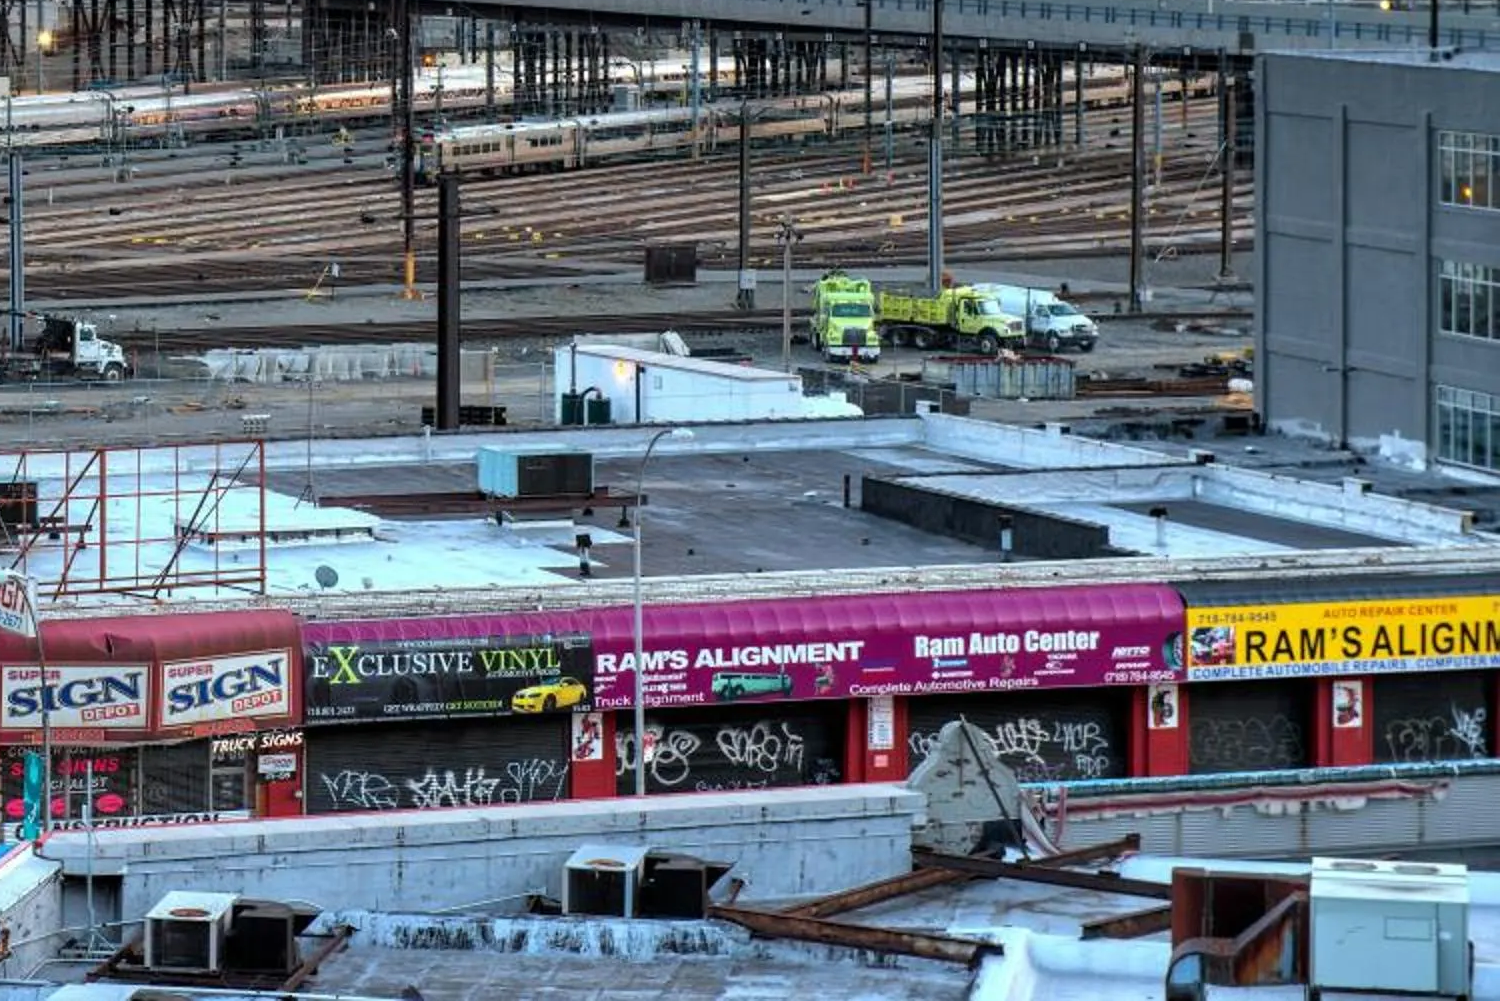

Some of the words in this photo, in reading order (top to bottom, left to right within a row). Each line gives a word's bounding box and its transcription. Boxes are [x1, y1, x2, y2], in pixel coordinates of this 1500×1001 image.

[1324, 607, 1356, 618] AUTO
[1359, 606, 1405, 617] REPAIR
[1407, 604, 1457, 615] CENTER
[914, 635, 965, 658] Ram
[968, 632, 1021, 656] Auto
[1023, 629, 1100, 652] Center
[1245, 626, 1362, 662] RAM'S
[479, 647, 561, 670] VINYL
[596, 649, 689, 674] RAM'S
[694, 640, 865, 669] ALIGNMENT
[7, 670, 61, 681] SUPER
[168, 663, 214, 678] SUPER
[1193, 666, 1263, 680] COMPLETE
[1266, 662, 1350, 677] AUTOMOBILE
[1353, 659, 1407, 671] REPAIRS
[7, 671, 143, 718] SIGN
[167, 657, 285, 716] SIGN
[849, 683, 912, 696] Complete
[913, 678, 987, 694] Automotive
[989, 676, 1039, 689] Repairs
[233, 690, 280, 713] DEPOT
[594, 696, 631, 708] Truck
[635, 692, 705, 707] lignment
[83, 704, 137, 721] DEPOT
[212, 736, 258, 752] TRUCK
[259, 732, 305, 749] SIGNS
